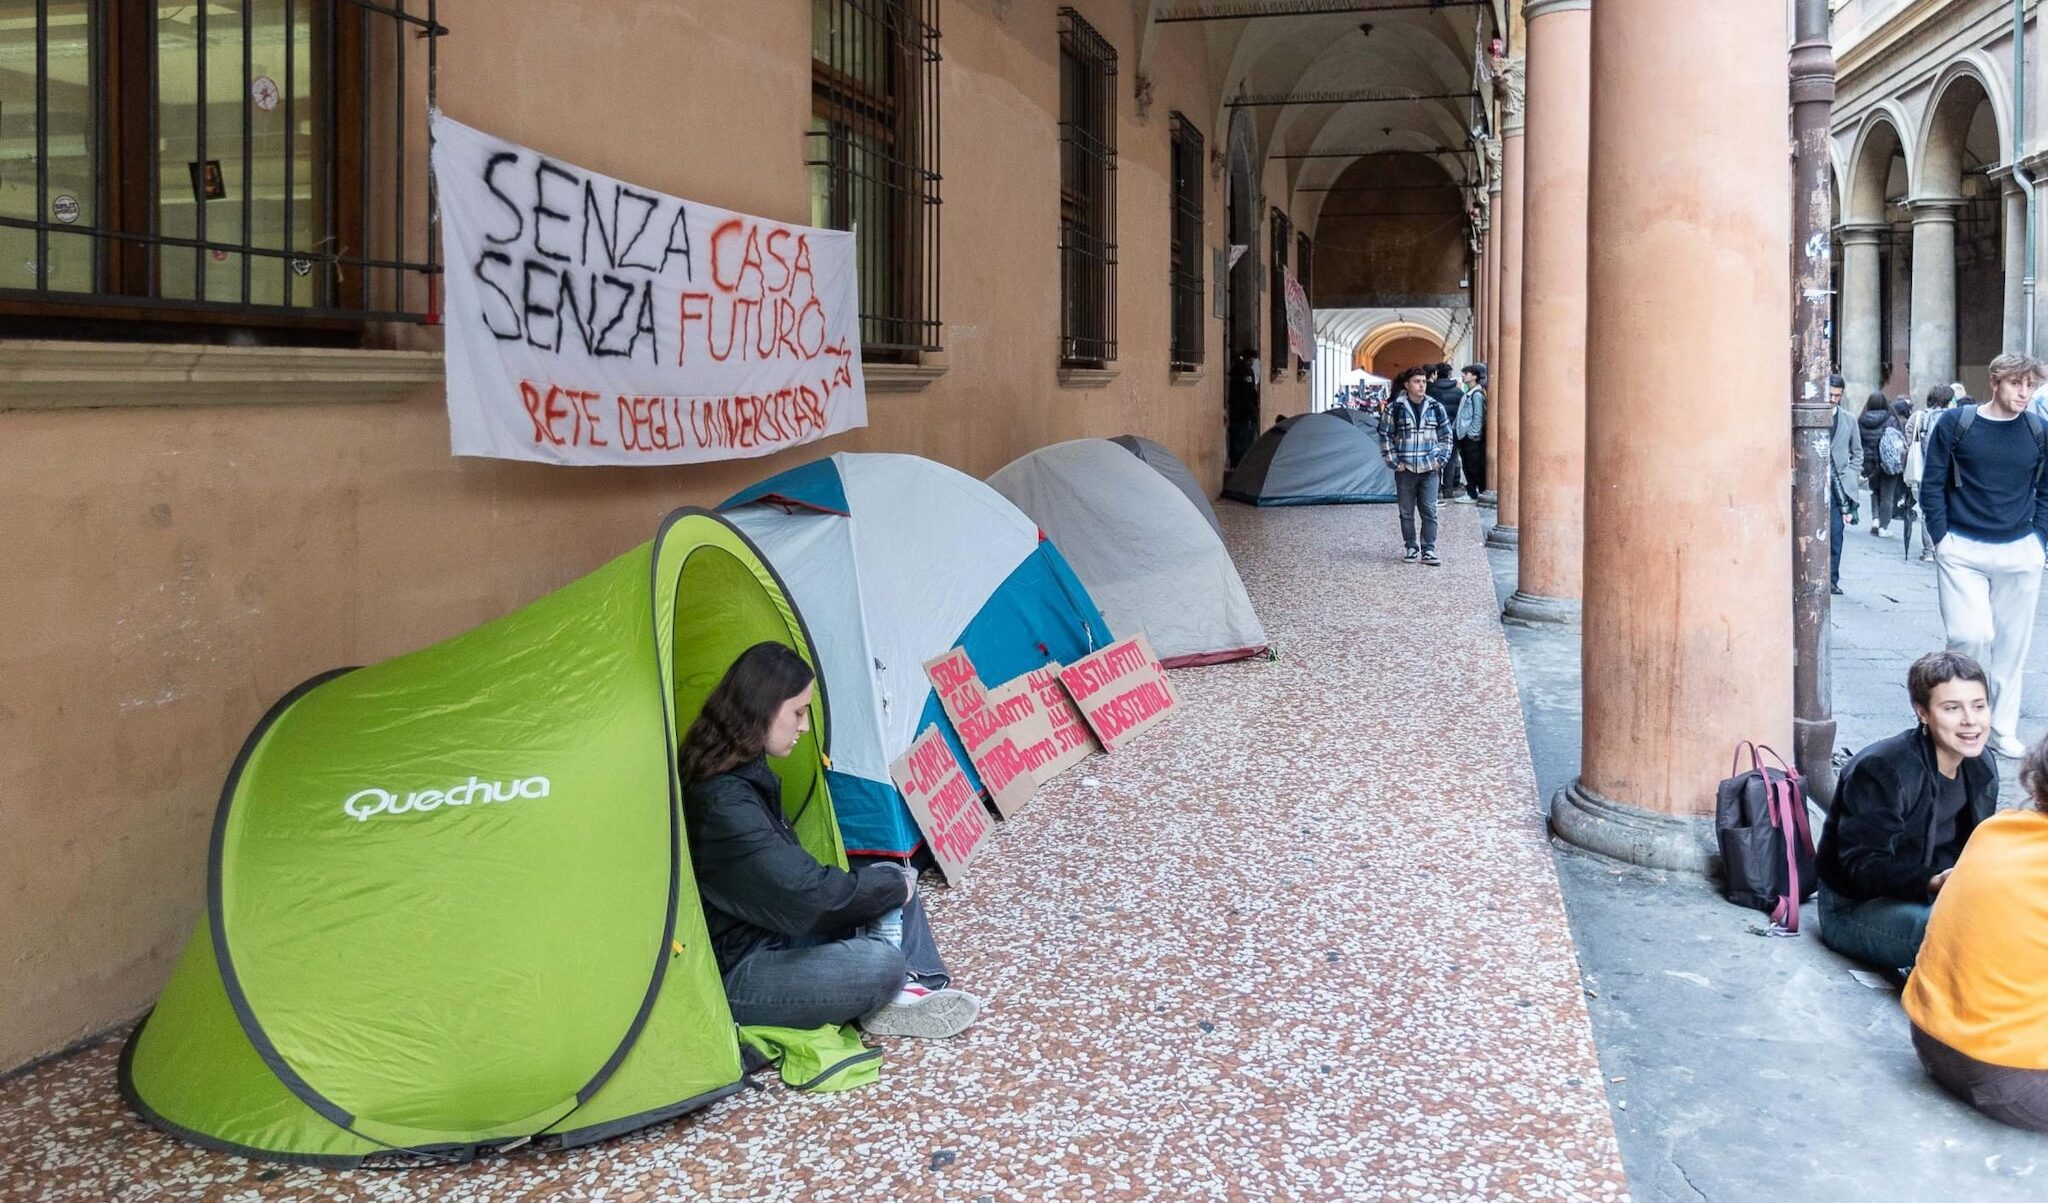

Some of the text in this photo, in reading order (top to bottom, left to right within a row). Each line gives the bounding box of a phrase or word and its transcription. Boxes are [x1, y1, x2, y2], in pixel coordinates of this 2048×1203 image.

[483, 151, 815, 300] SENZA CASA
[475, 250, 826, 368] SENZA FUTURO
[519, 378, 608, 449] RETE
[617, 395, 685, 451] DEGLI
[930, 653, 977, 699] SENZA
[950, 682, 986, 720] CASA
[996, 692, 1035, 729] RITTO
[343, 775, 551, 823] Quechua
